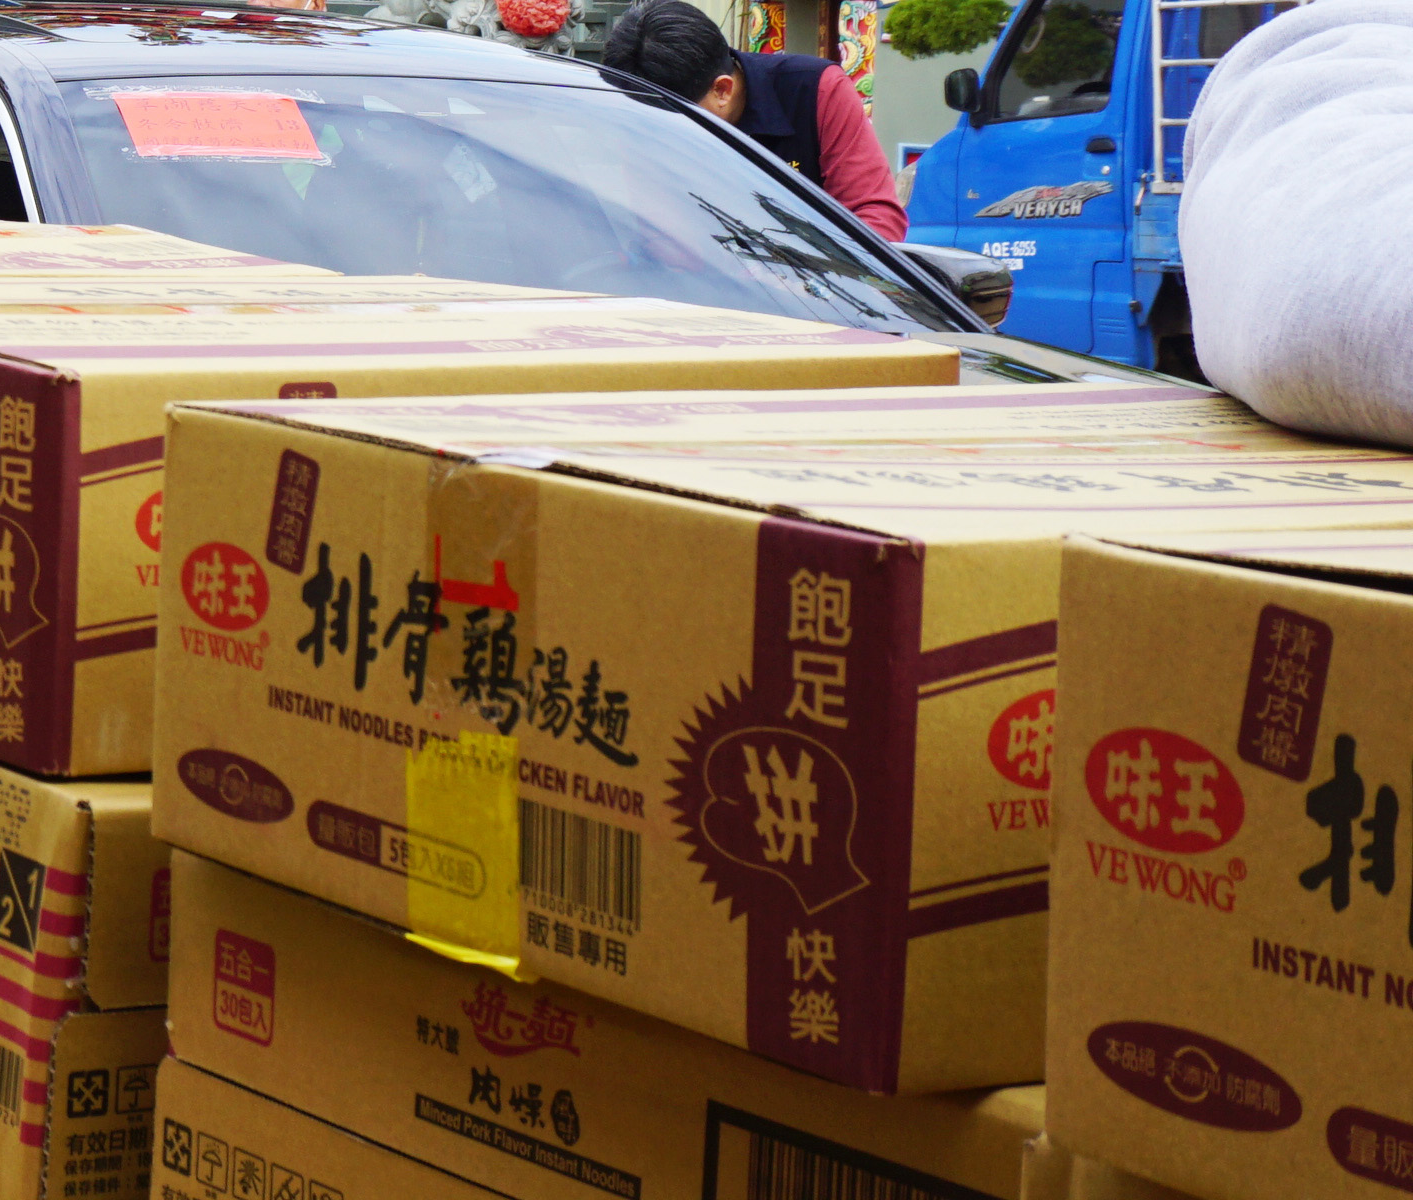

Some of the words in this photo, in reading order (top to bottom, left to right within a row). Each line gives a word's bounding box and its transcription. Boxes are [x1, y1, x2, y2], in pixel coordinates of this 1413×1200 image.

[192, 546, 260, 624] 味王
[785, 565, 853, 732] 飽足
[267, 685, 336, 726] INSTANT
[338, 701, 414, 748] NOODLES
[573, 774, 646, 820] FLAVOR
[743, 743, 821, 868] 拼
[1105, 739, 1224, 845] 味王
[27, 868, 40, 909] 1
[219, 941, 270, 982] 五合一
[525, 910, 629, 977] 販售專用
[1252, 936, 1376, 1000] INSTANT
[218, 987, 269, 1035] 30包入
[785, 927, 840, 1047] 快樂
[415, 1014, 461, 1058] 特大號
[420, 1098, 462, 1134] Minced
[463, 1113, 492, 1145] Pork
[494, 1121, 533, 1161] Flavor
[534, 1136, 579, 1177] Instant
[581, 1152, 637, 1200] Noodles
